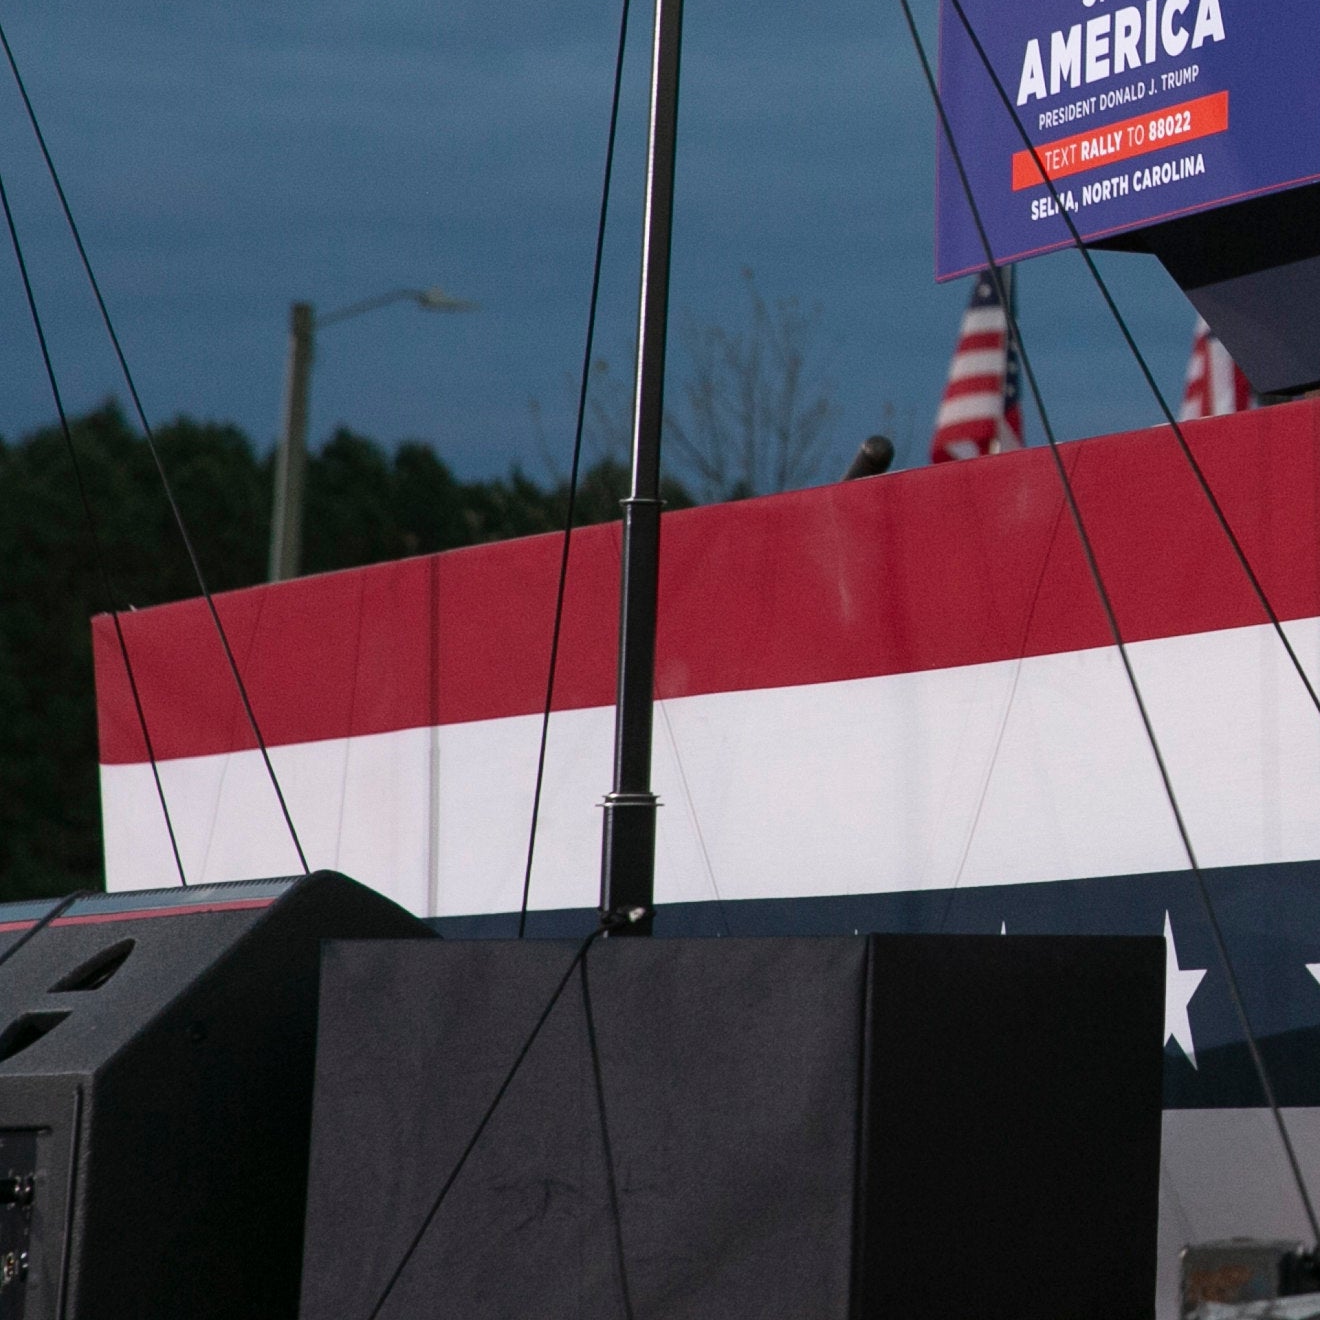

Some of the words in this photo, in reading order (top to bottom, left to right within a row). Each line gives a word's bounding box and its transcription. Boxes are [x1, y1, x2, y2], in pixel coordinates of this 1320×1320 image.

[1038, 96, 1097, 130] PRESIDENT
[1099, 82, 1146, 111] DONALD
[1148, 78, 1158, 95] J.
[1161, 64, 1200, 91] TRUMP
[1045, 143, 1078, 171] TEXT
[1080, 130, 1123, 161] RALLY
[1126, 124, 1145, 147] TO
[1149, 110, 1192, 141] 88022
[1082, 174, 1129, 206] NORTH
[1132, 153, 1206, 192] CAROLINA
